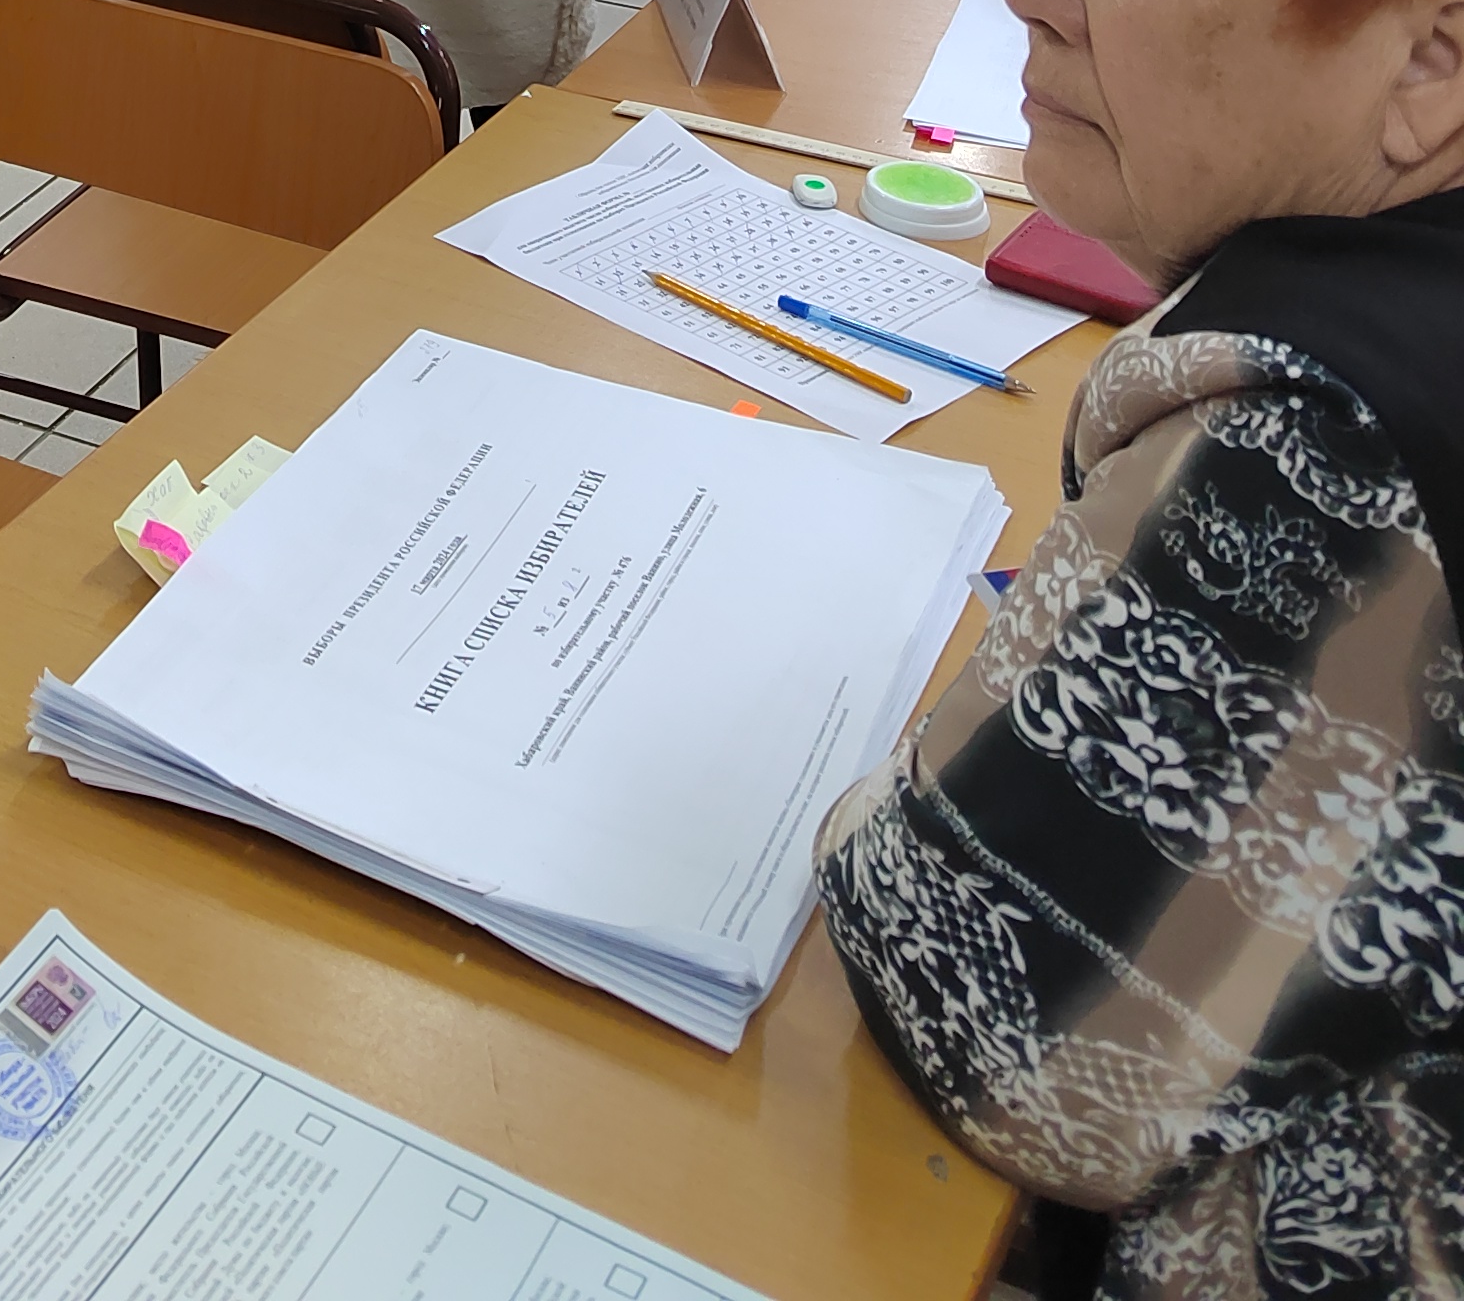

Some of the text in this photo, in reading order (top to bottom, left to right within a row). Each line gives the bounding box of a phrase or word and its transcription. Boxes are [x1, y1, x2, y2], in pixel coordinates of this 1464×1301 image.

[302, 620, 347, 666] ВЫБОРЫ
[344, 561, 400, 620] ПРЕЗИДЕНТА
[394, 496, 451, 562] РОССИЙСКОЙ
[446, 442, 493, 498] ФЕДЕРАЦИИ
[414, 652, 476, 714] КНИГА
[463, 586, 529, 652] СПИСКА
[515, 468, 607, 586] ИЗБИРАТЕЛЕЙ
[419, 567, 438, 587] марта
[432, 548, 452, 570] 2024
[557, 596, 571, 610] из
